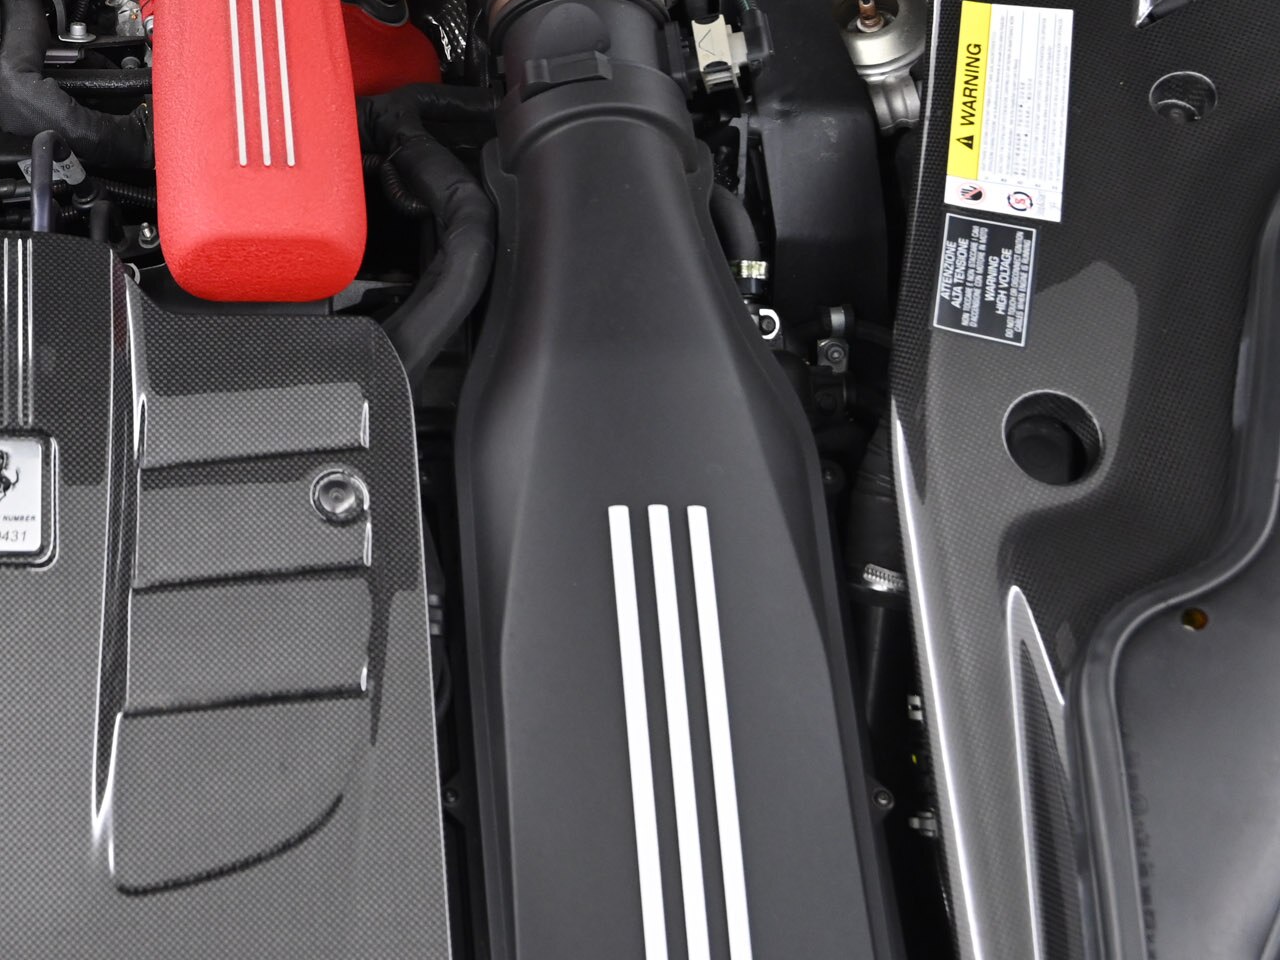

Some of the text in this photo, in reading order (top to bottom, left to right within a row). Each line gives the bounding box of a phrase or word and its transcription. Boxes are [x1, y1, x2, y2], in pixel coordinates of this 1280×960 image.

[960, 43, 982, 126] WARNING
[941, 241, 956, 298] ATTENZIONE
[951, 238, 968, 307] ALTA TENSIONE
[985, 256, 999, 301] WARNING
[996, 248, 1012, 314] HIGH VOLTAGE
